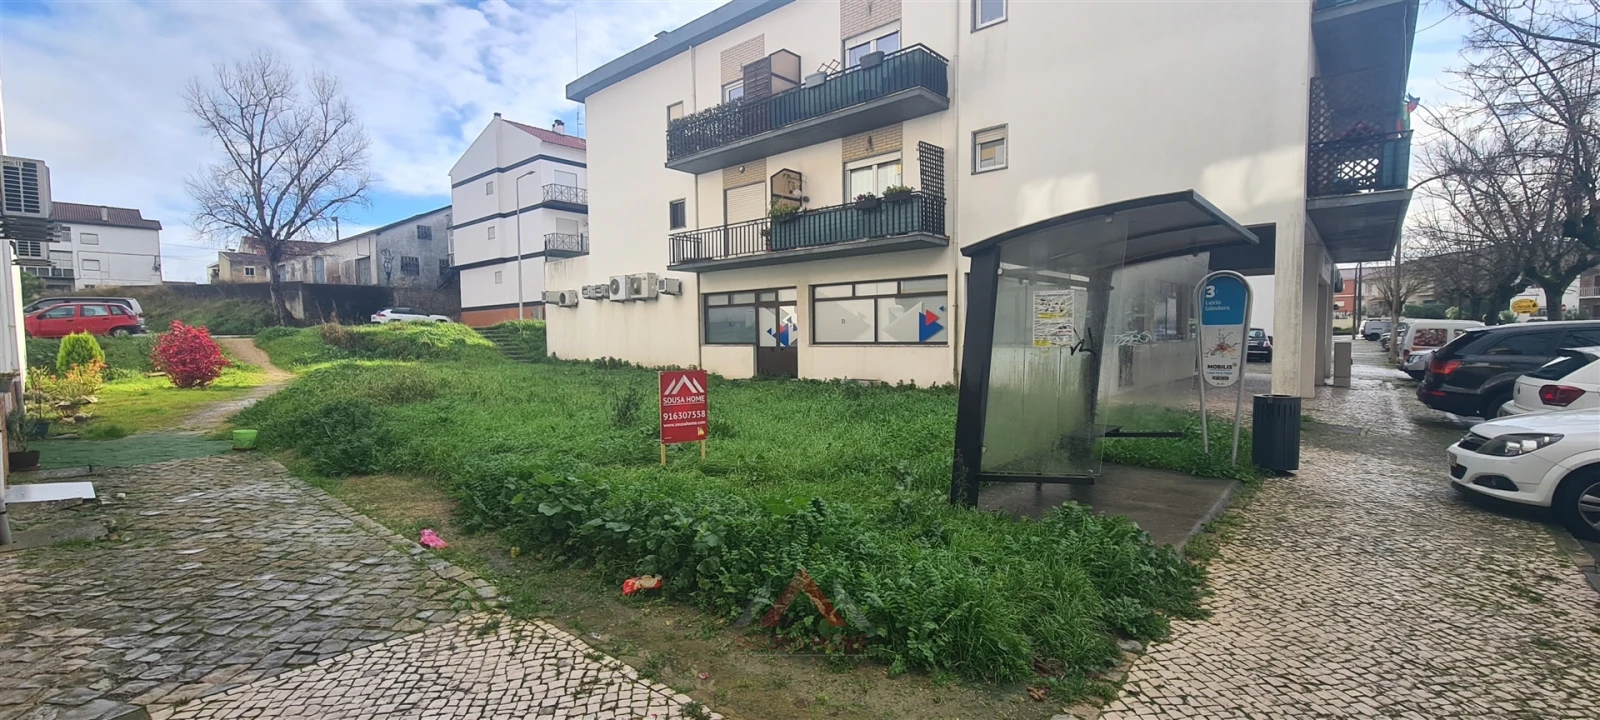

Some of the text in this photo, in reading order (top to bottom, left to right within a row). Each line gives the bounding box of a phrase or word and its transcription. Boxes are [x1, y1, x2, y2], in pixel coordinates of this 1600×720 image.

[1205, 285, 1215, 298] 3
[663, 396, 685, 404] SOUSA
[663, 410, 706, 421] 916307558
